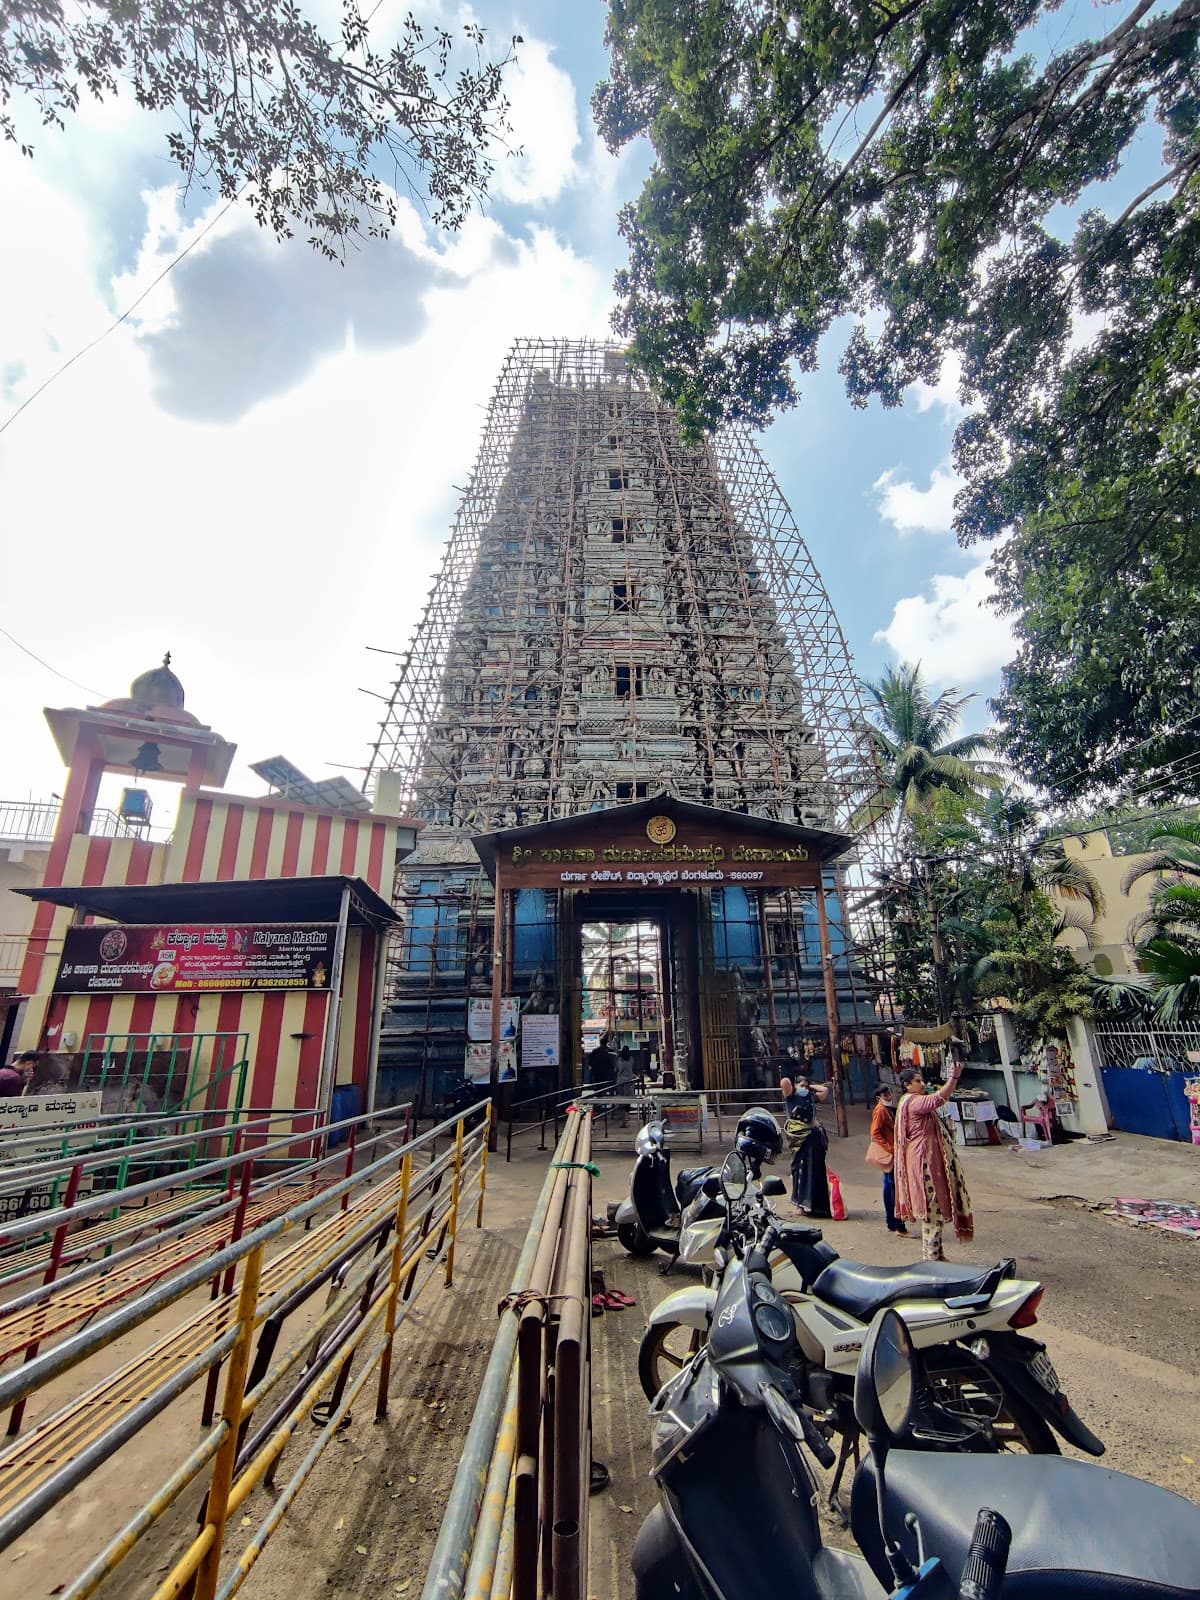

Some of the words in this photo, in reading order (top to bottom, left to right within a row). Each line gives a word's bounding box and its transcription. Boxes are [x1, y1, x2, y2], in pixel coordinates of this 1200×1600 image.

[560, 871, 588, 881] ದುರ್ಗಾ
[681, 870, 724, 880] ಬೆಂಗಳೂರು
[168, 929, 200, 951] ಕಲ್ಯಾಣ
[203, 929, 229, 950] ಮಸ್ತು
[253, 931, 291, 946] Kalyana
[292, 931, 327, 944] Masthu
[45, 1098, 77, 1114] ಮಸ್ತು
